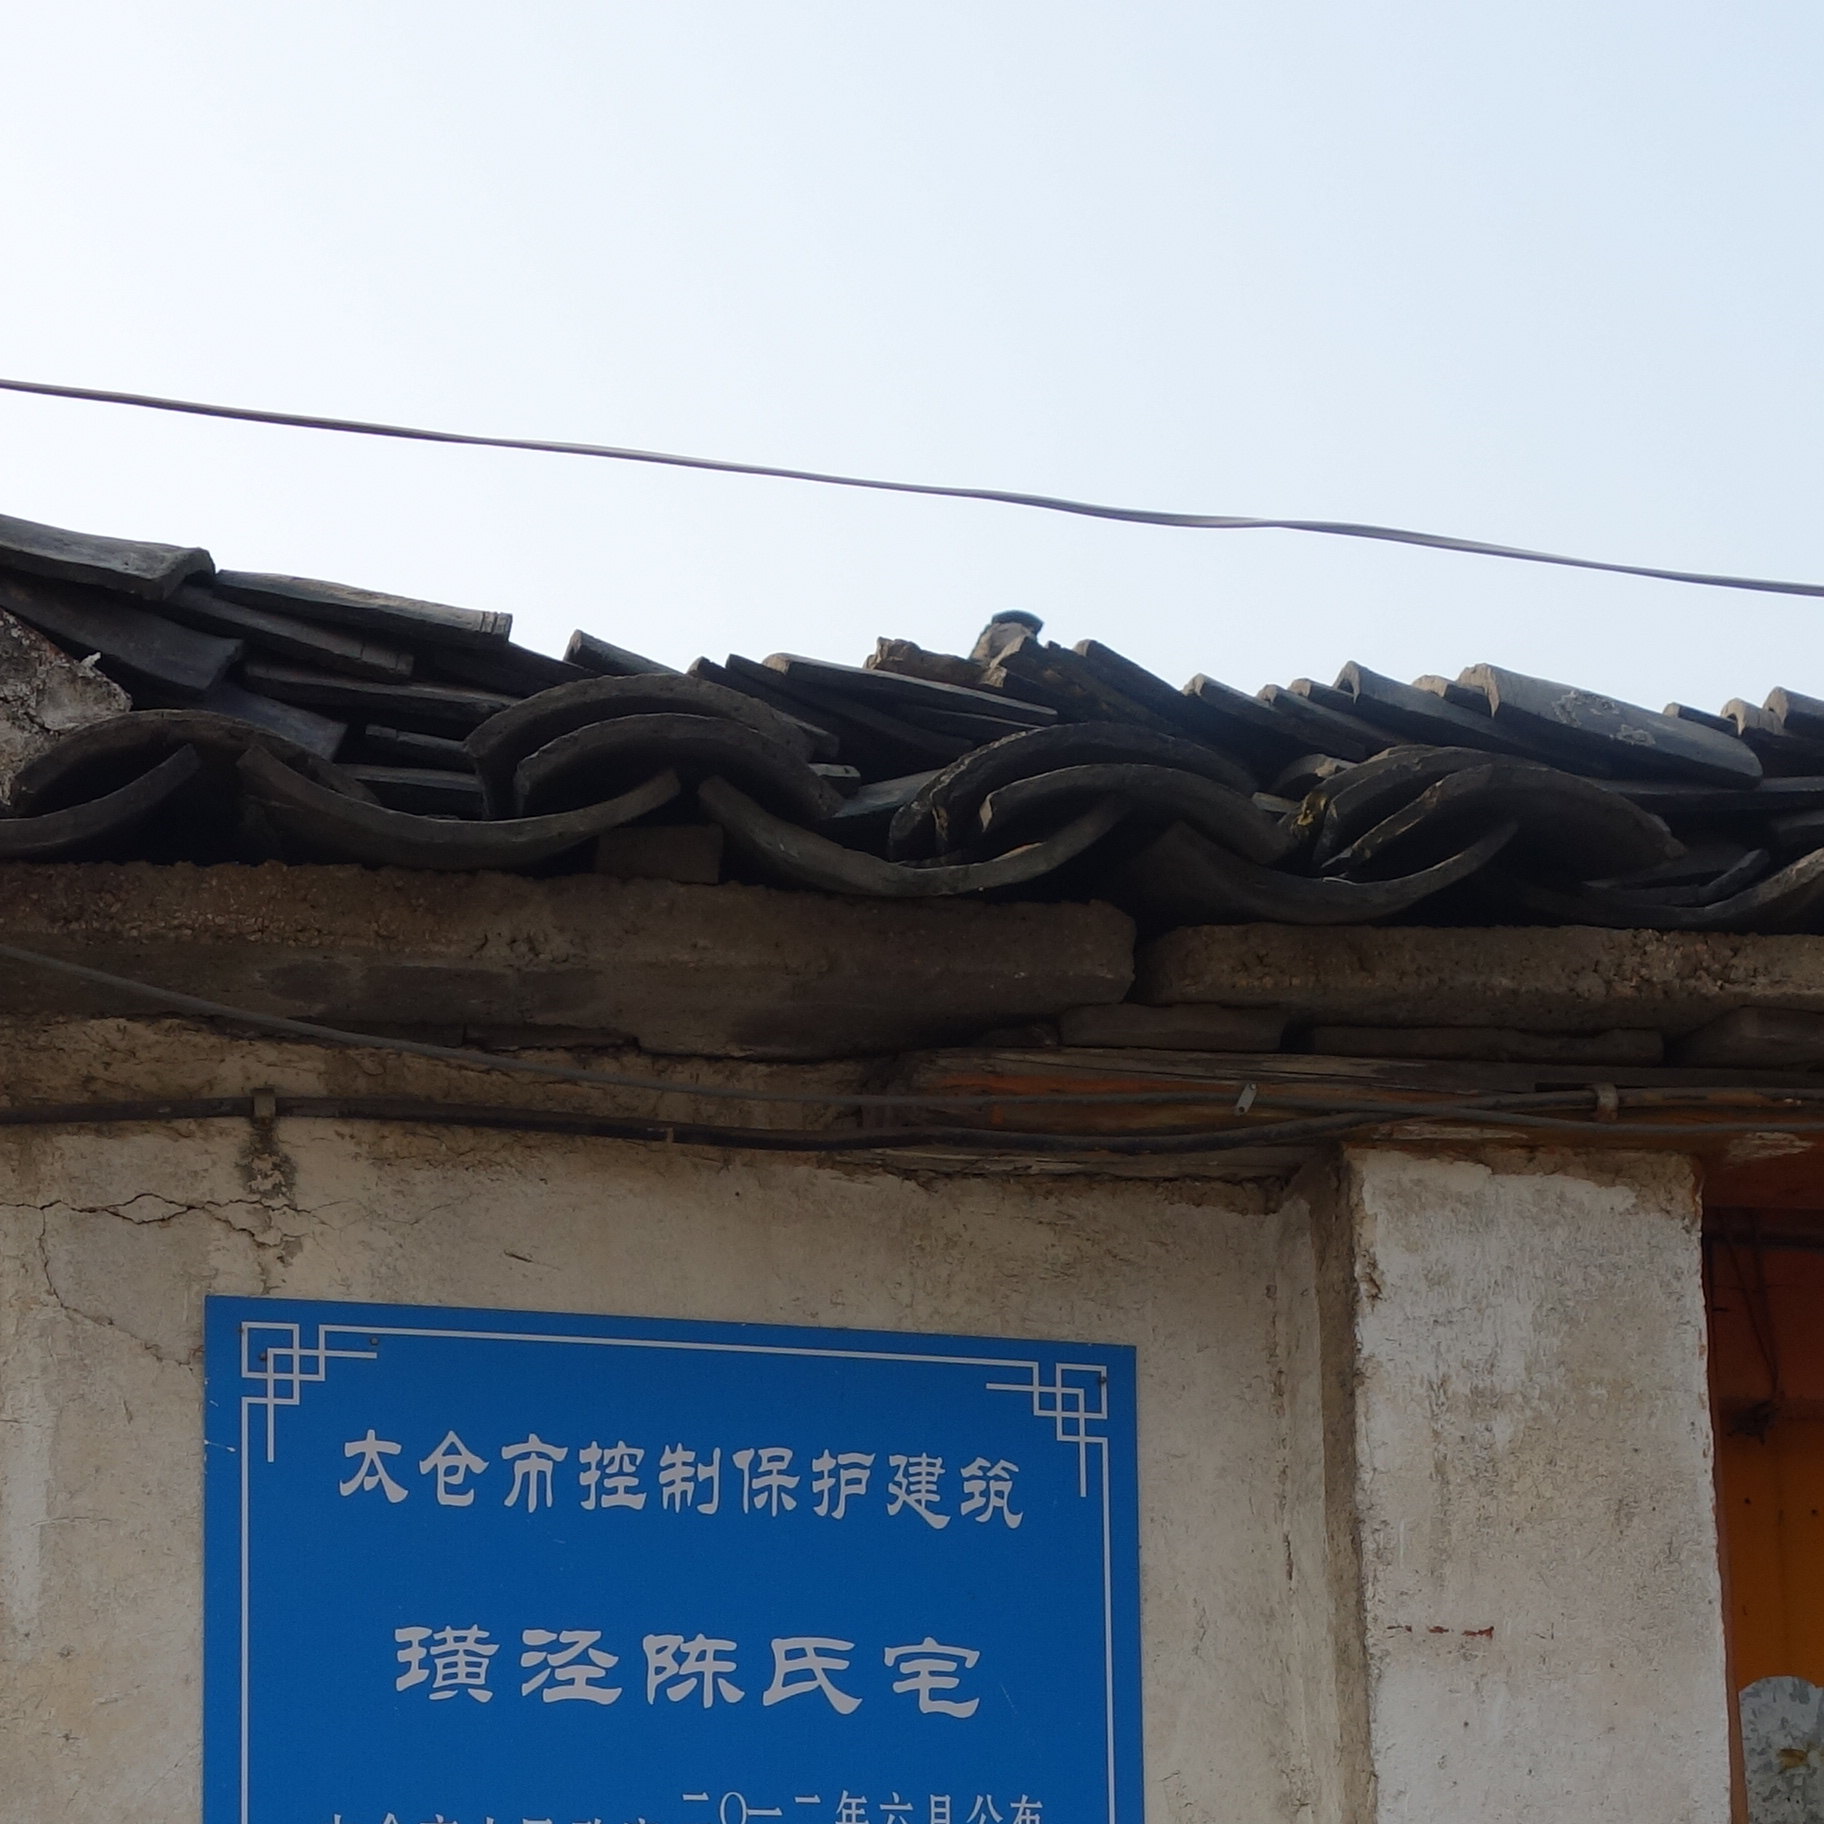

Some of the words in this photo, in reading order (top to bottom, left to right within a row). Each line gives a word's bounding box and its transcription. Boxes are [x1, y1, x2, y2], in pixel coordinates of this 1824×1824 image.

[338, 1430, 1024, 1530] 太仓市控制保护建筑
[394, 1624, 980, 1718] 璜泾陈氏宅
